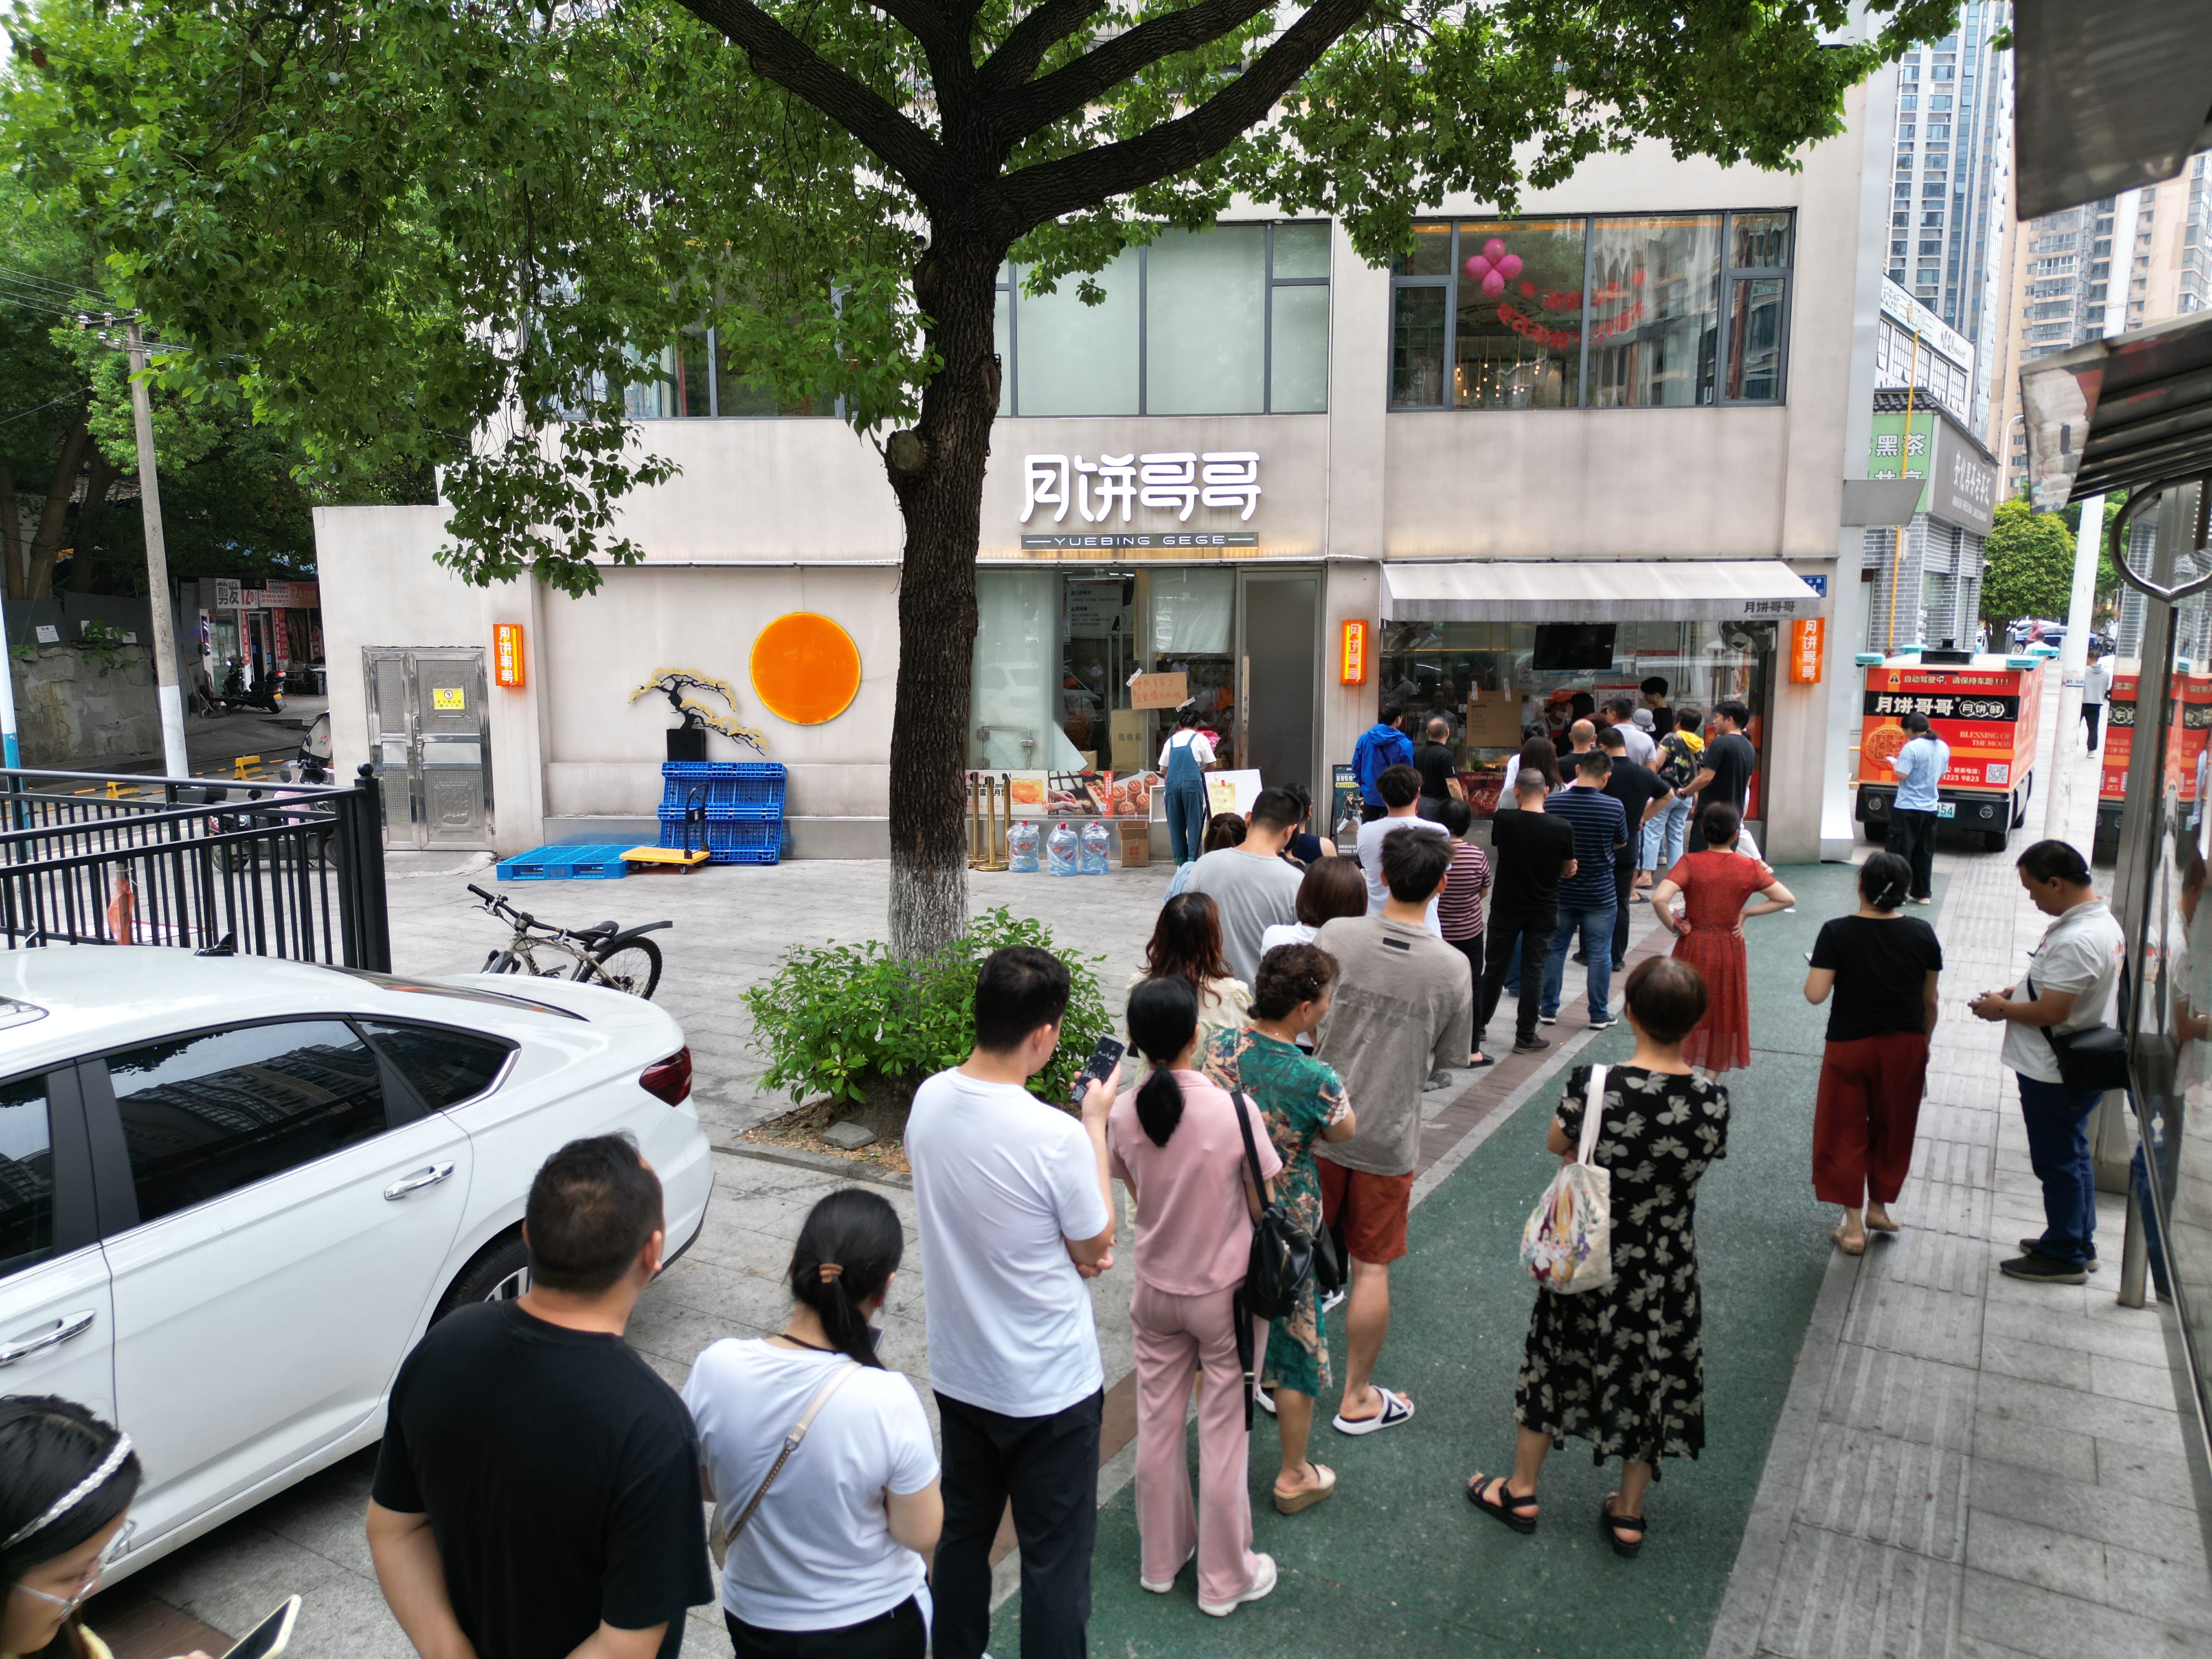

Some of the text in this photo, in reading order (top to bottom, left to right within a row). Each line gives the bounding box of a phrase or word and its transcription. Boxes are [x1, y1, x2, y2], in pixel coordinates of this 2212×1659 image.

[1870, 433, 1926, 458] 黑茶
[1019, 452, 1261, 522] 月饼哥哥
[1054, 535, 1226, 546] YUEBING GEGE
[1744, 601, 1796, 613] 月饼哥哥
[499, 627, 514, 684] 月饼哥哥
[1348, 623, 1361, 682] 月饼哥哥
[1802, 620, 1818, 680] 月饼哥哥
[1875, 696, 1954, 716] 月饼哥哥
